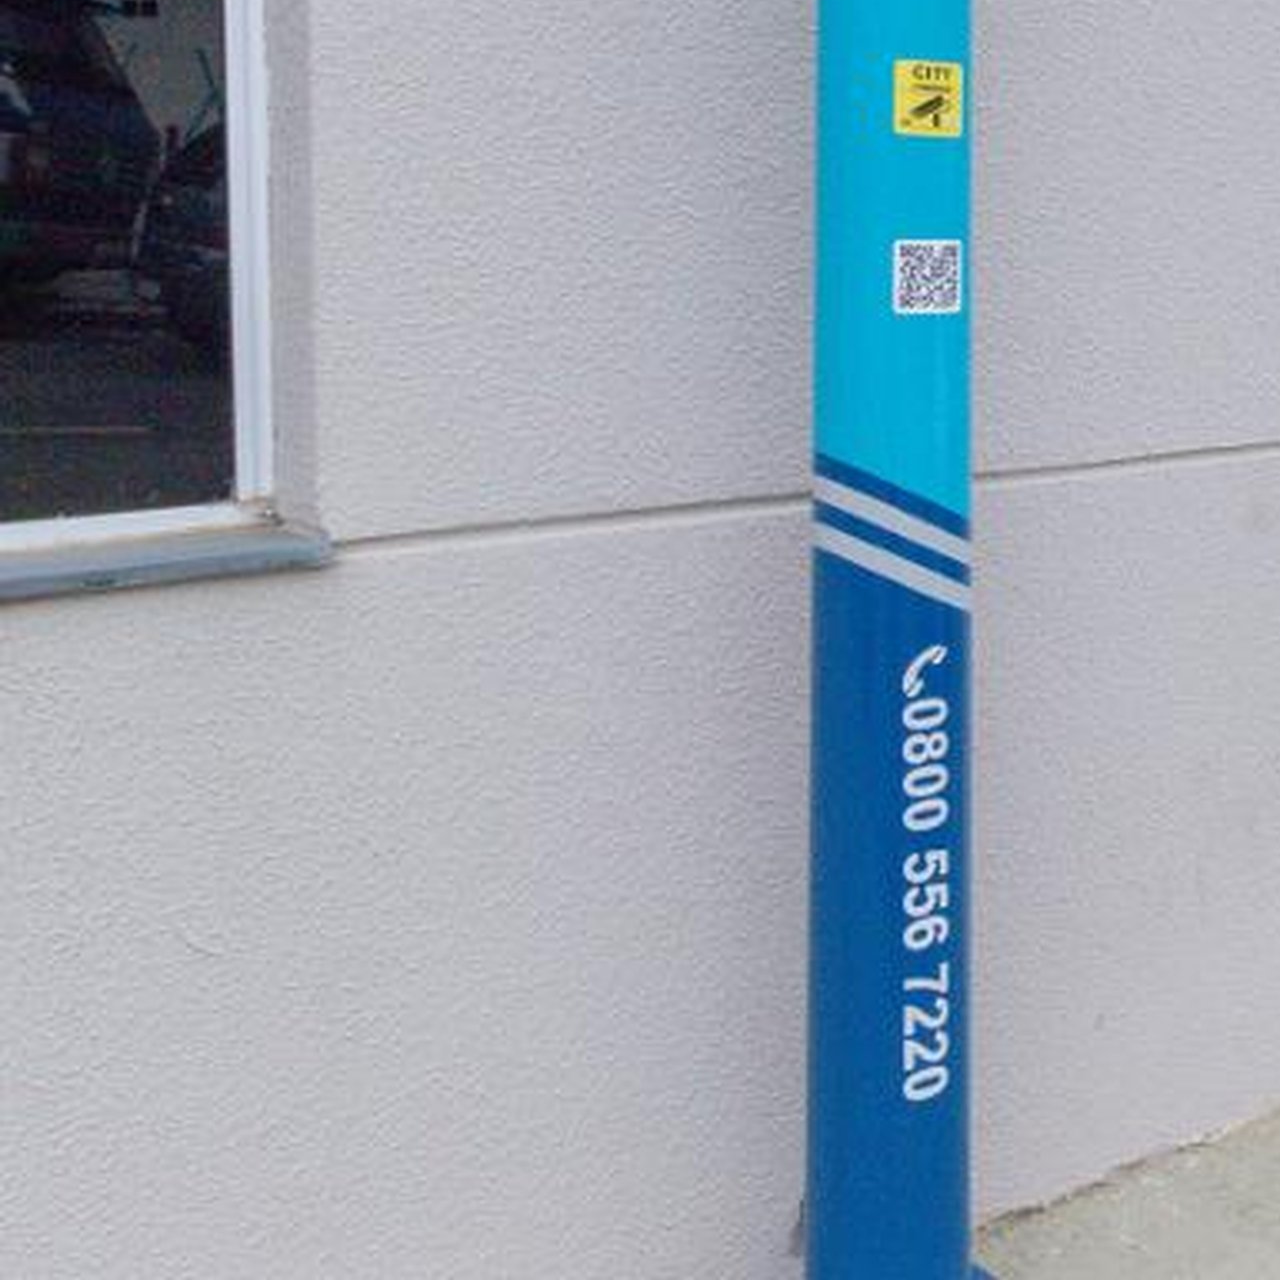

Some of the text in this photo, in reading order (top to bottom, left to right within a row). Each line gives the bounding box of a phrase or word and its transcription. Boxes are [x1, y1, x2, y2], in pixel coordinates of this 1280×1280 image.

[902, 696, 950, 1102] 0800 556 7220
